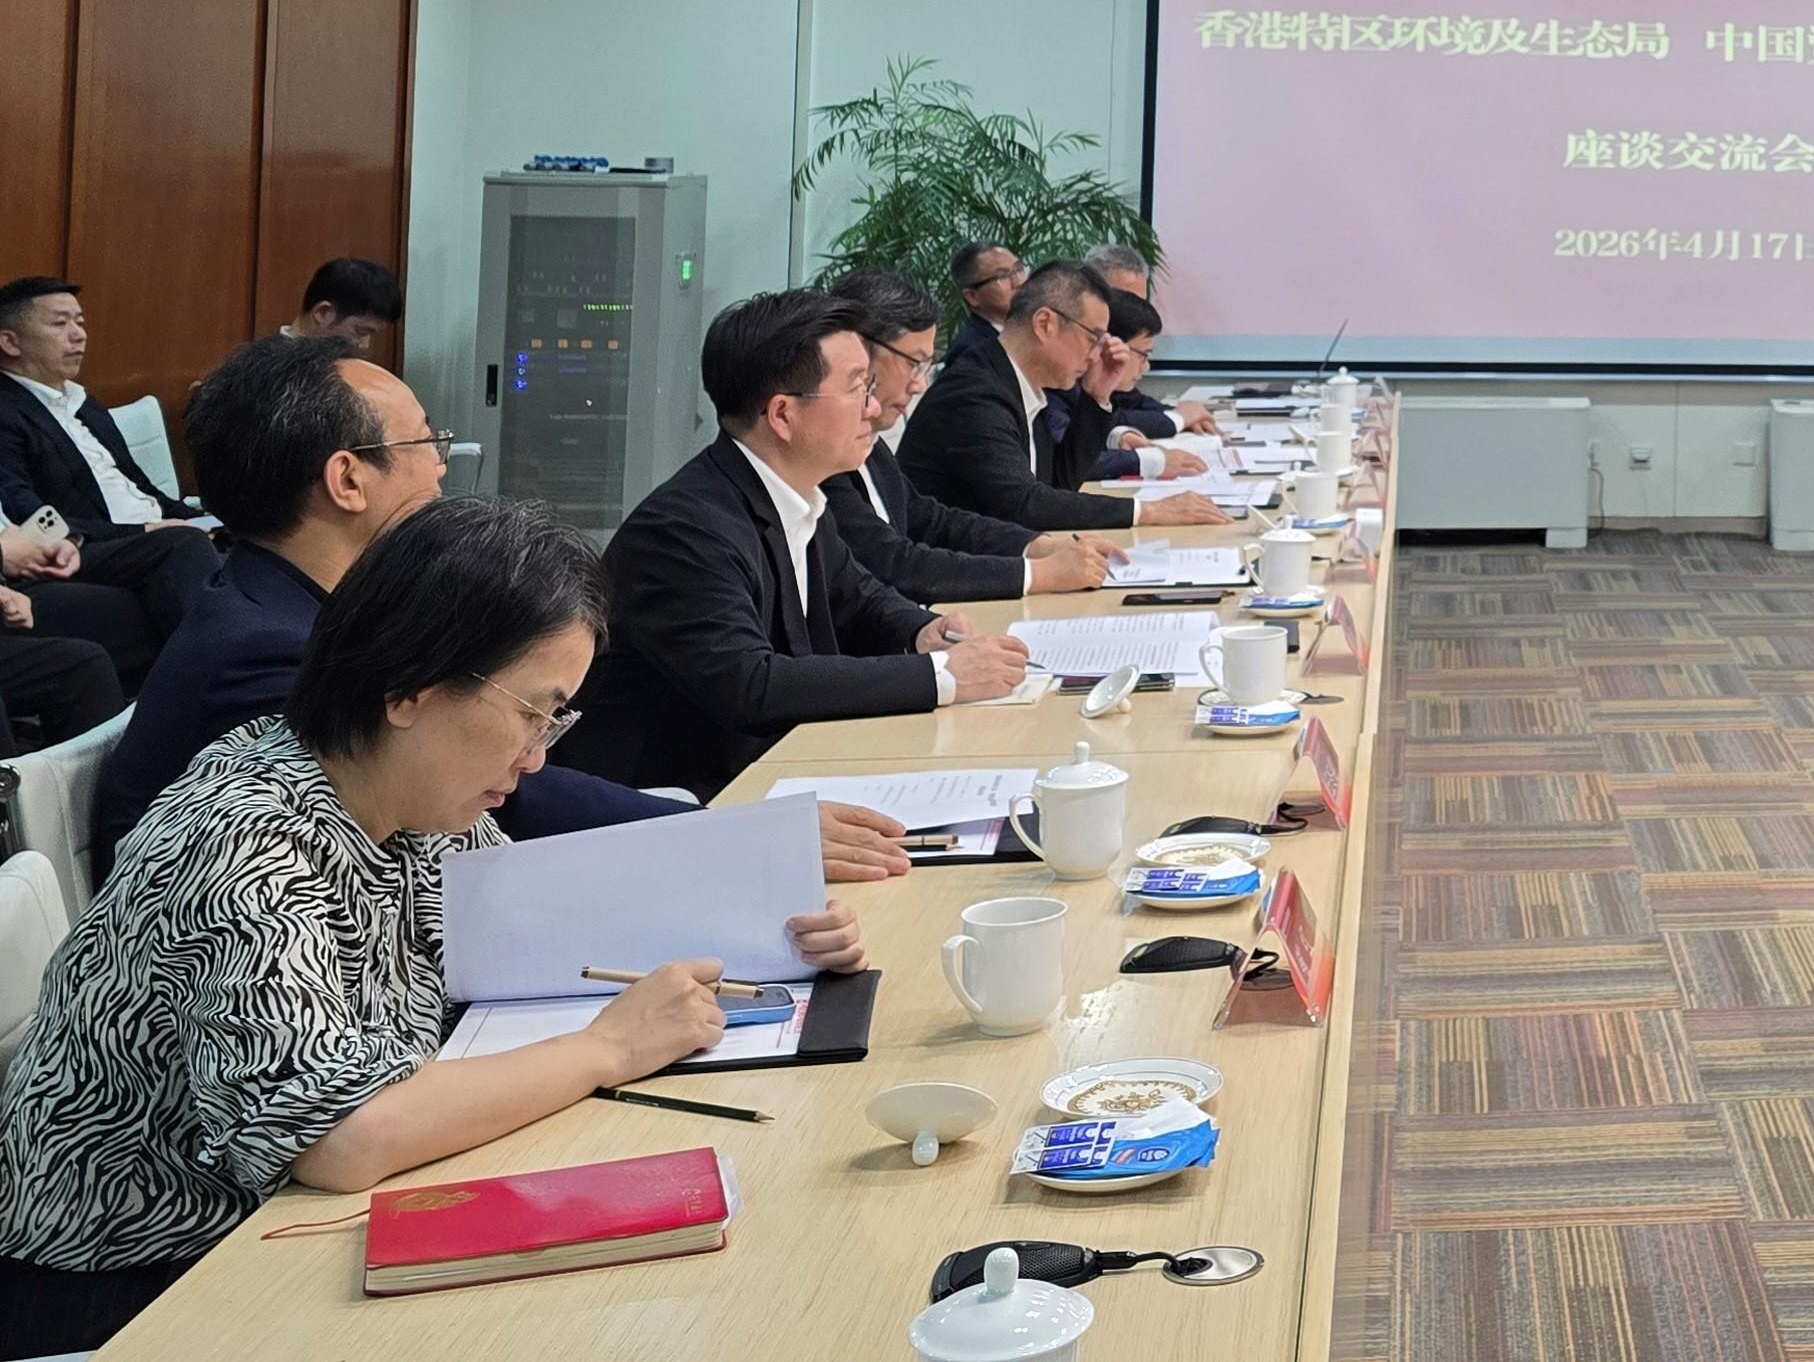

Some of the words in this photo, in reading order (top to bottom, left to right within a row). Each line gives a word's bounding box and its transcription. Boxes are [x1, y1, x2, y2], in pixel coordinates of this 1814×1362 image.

[1193, 9, 1670, 60] 香港特区环境及生态局
